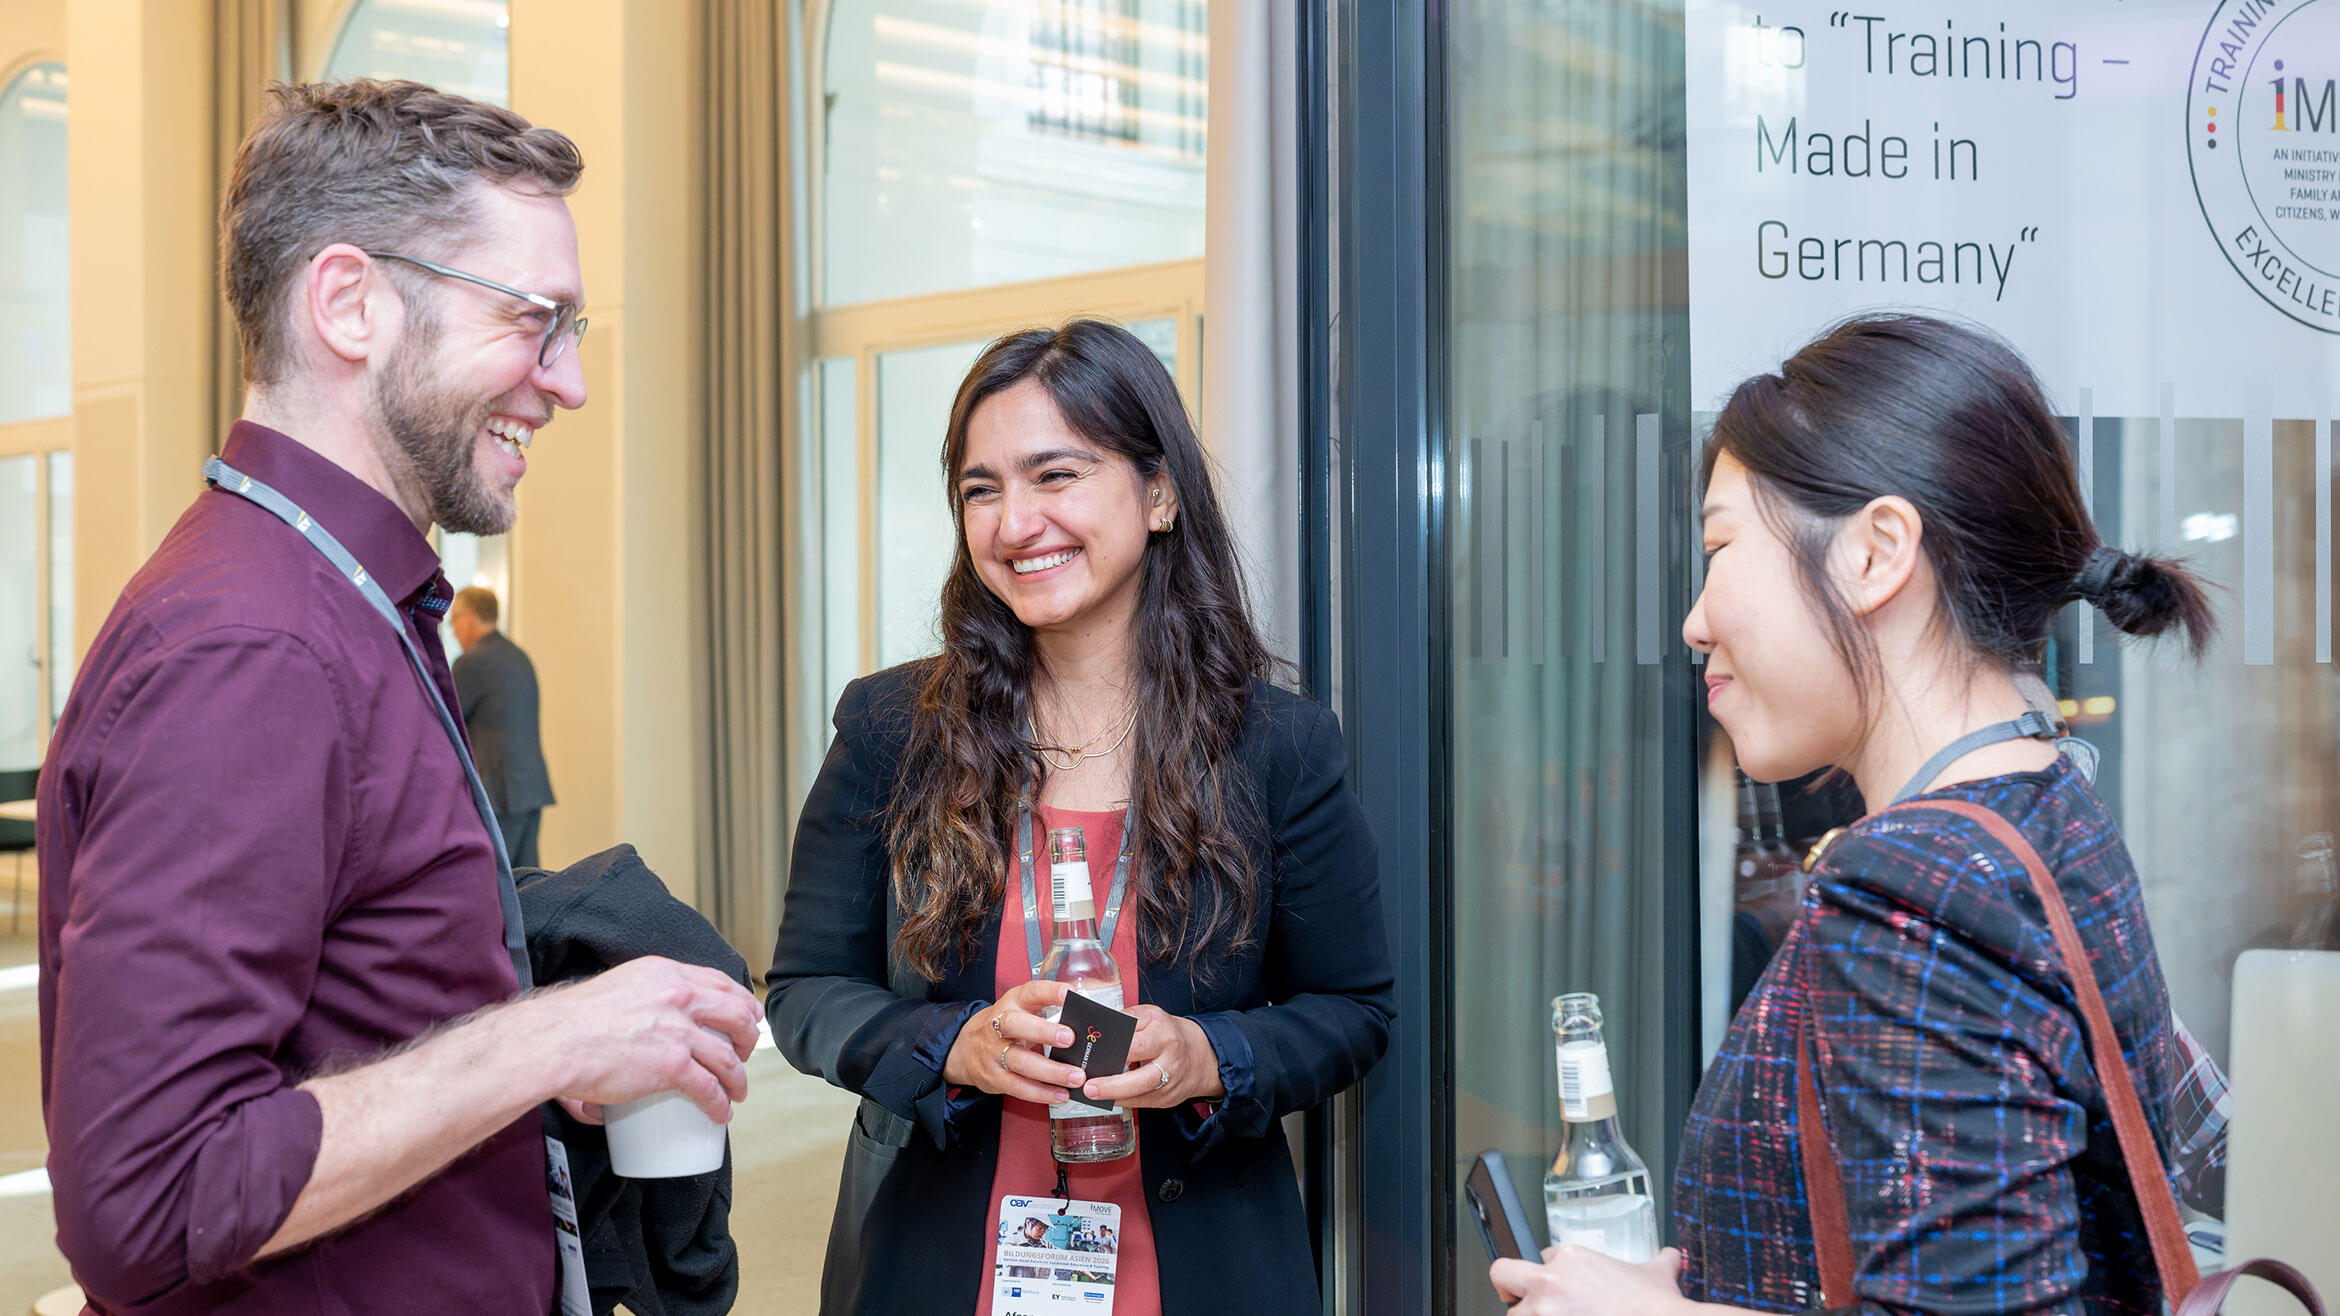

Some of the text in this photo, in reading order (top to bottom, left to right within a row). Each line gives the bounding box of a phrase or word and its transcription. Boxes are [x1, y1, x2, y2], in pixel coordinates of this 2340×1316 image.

[1757, 116, 1978, 181] Made in
[2273, 148, 2340, 164] AN INITIATIV
[2284, 168, 2336, 183] MINISTRY
[2290, 187, 2328, 202] FAMILY
[2275, 206, 2327, 222] CITIZENS,
[1105, 910, 1117, 918] EY
[1003, 1250, 1068, 1261] BILDUNGSFORUM
[1069, 1255, 1091, 1263] ASIEN
[1092, 1257, 1110, 1265] 2026
